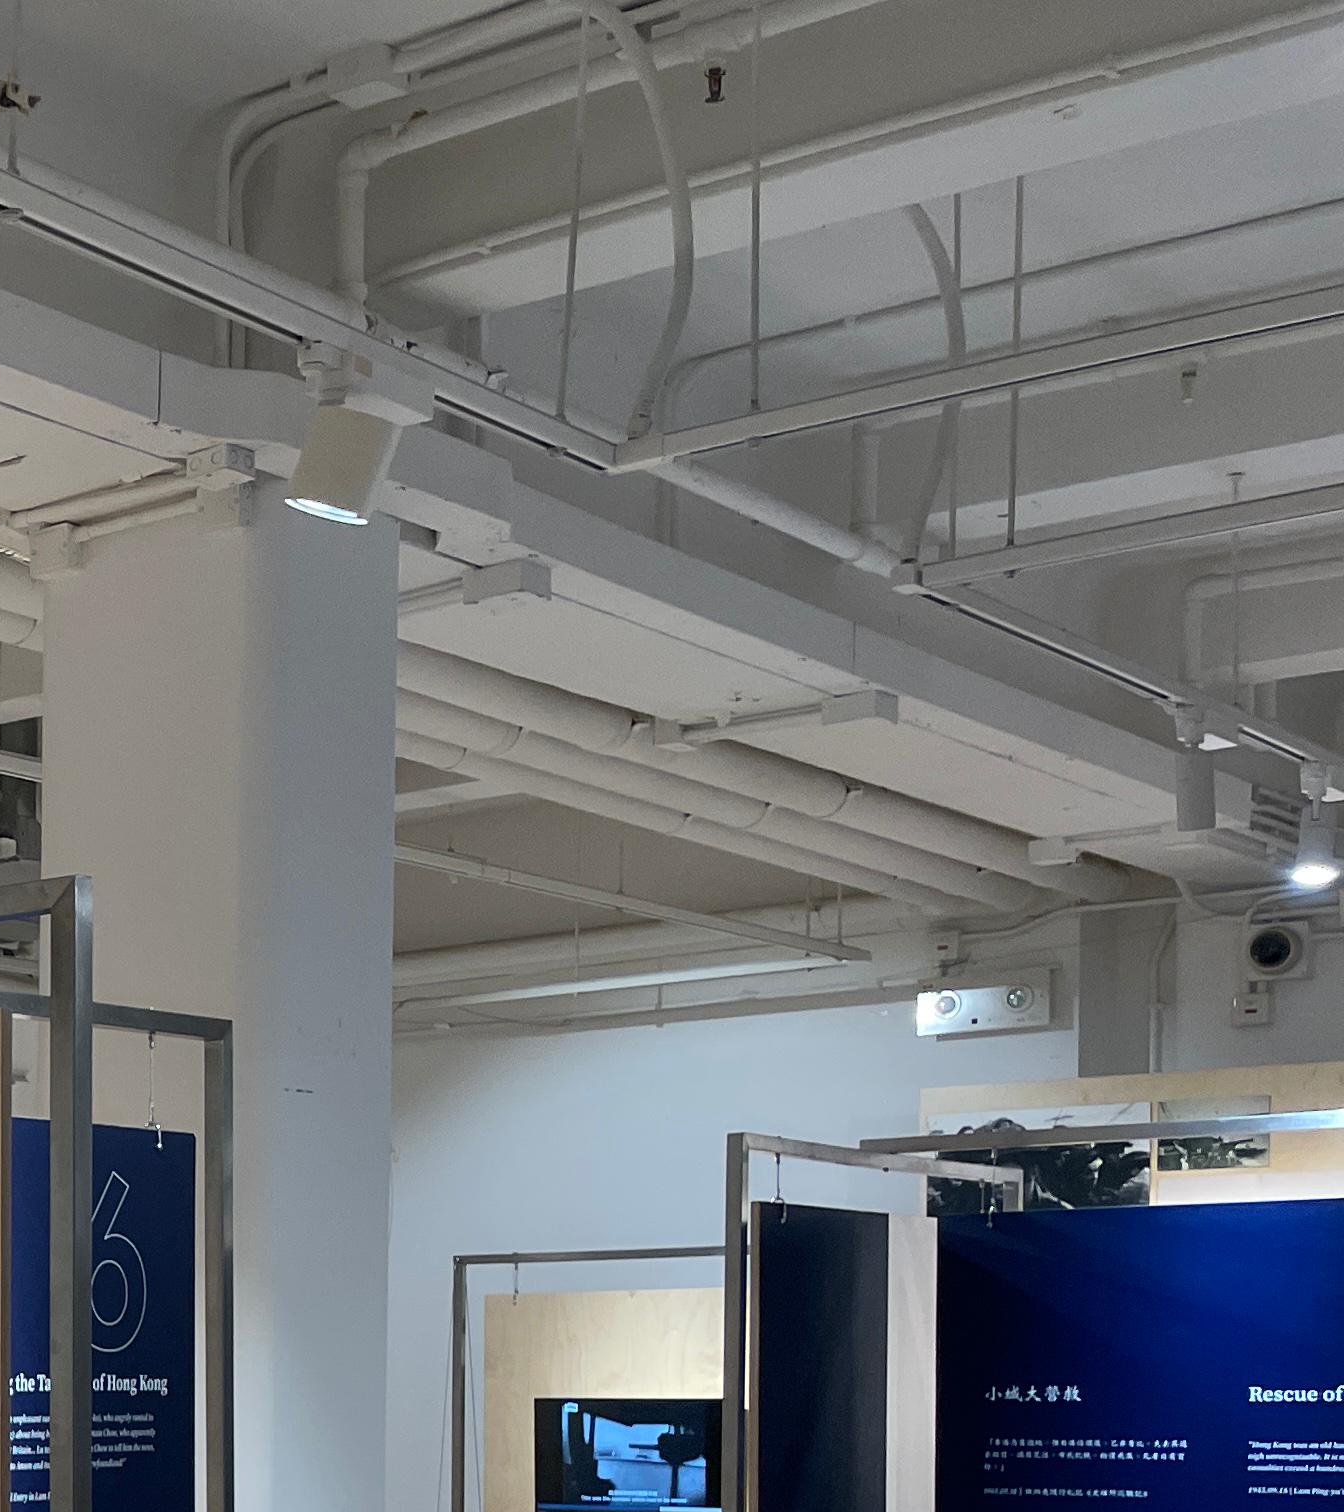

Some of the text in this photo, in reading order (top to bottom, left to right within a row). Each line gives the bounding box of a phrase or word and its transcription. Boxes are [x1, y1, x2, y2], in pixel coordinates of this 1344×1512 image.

[91, 1171, 147, 1353] 6
[16, 1373, 35, 1392] the
[93, 1373, 168, 1396] of Hong Kong
[1249, 1385, 1343, 1402] Rescue of
